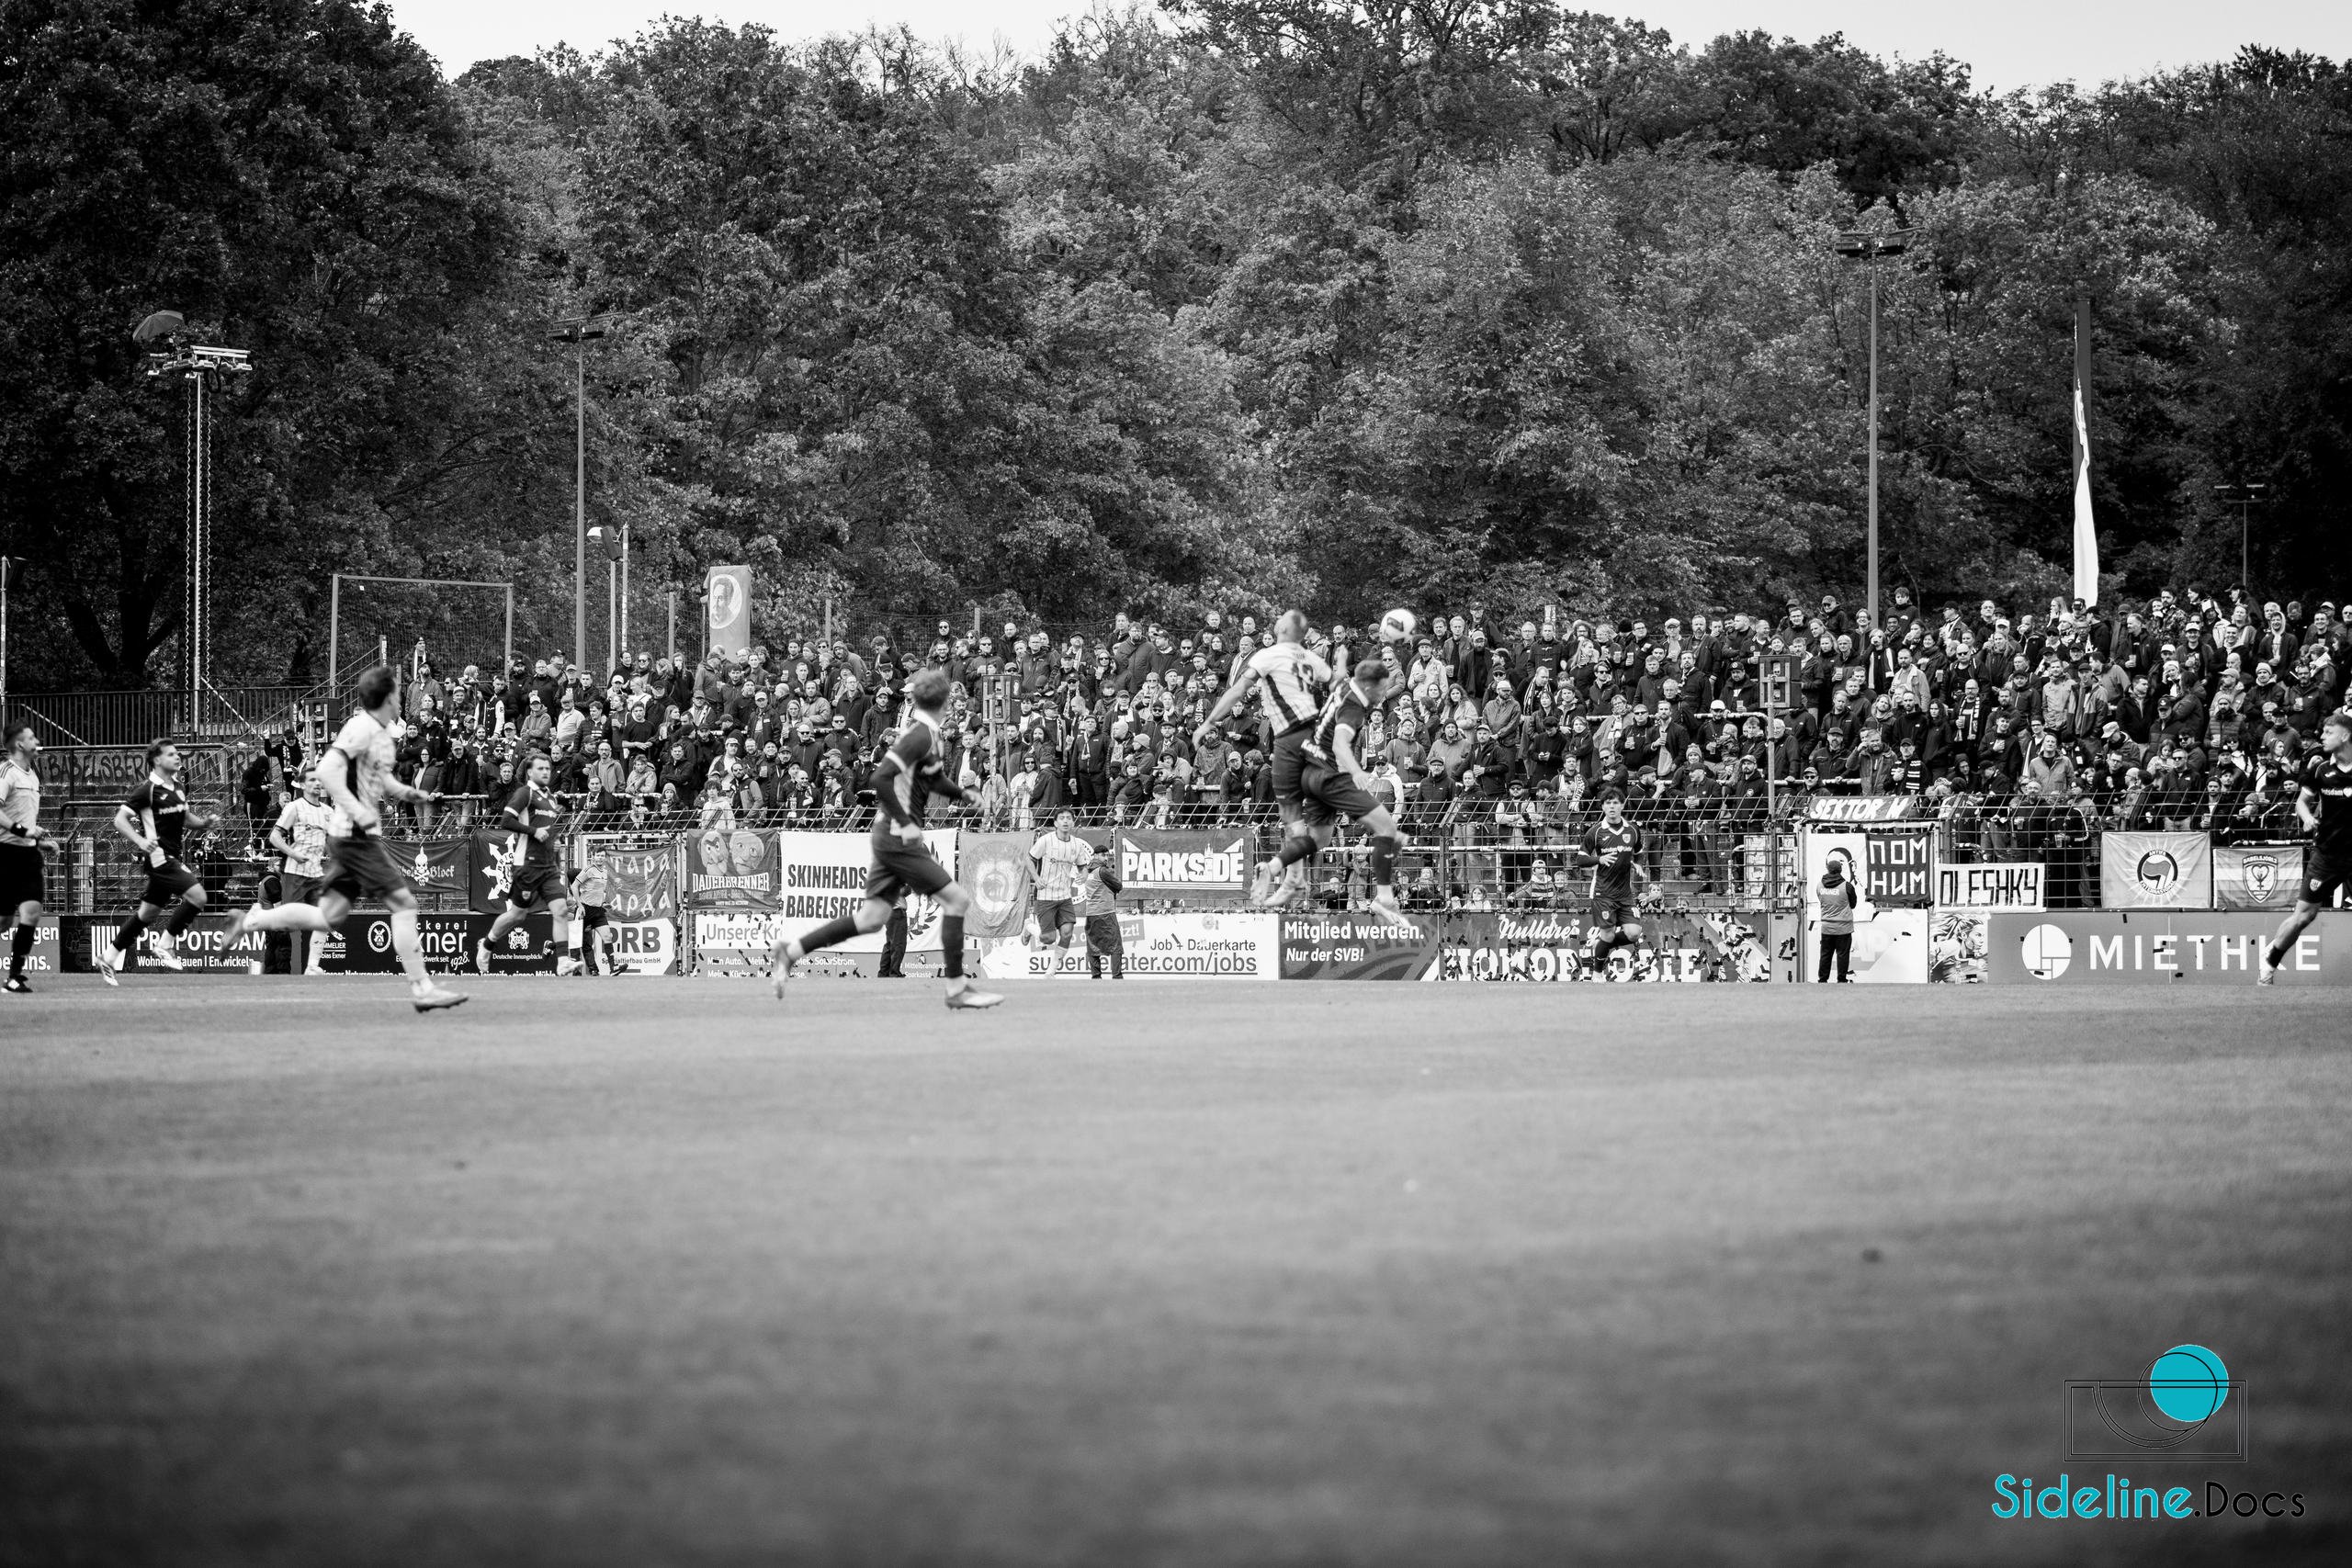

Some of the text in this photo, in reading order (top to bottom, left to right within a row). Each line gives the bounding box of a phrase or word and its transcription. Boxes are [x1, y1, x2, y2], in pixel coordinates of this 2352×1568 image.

[50, 753, 152, 783] BABELSBER
[1810, 798, 1883, 820] SEKTOR
[1870, 837, 1926, 864] ПОМ
[610, 853, 671, 879] ТАРА
[1122, 843, 1244, 883] PARKSIDE
[692, 872, 770, 893] DAUERBRENNER
[787, 864, 867, 889] SKINHEADS
[1871, 871, 1926, 895] НИМ
[610, 891, 672, 917] АРДА
[786, 896, 867, 919] BABELSBE
[416, 920, 467, 931] ckerei
[707, 923, 781, 940] Unsere Kr
[1120, 924, 1139, 937] tzt!
[1284, 921, 1351, 943] Mitglied
[137, 927, 266, 951] PRPOTSAM
[602, 927, 661, 953] PRB
[1151, 939, 1172, 951] Job
[1188, 939, 1256, 951] Dauerkarte
[138, 956, 165, 967] Wohne
[209, 956, 254, 967] Enwickel
[424, 954, 438, 963] dwerk
[439, 953, 449, 963] seit
[1029, 952, 1257, 976] suereater.com/jobs
[1286, 948, 1364, 962] Nur der SVB!
